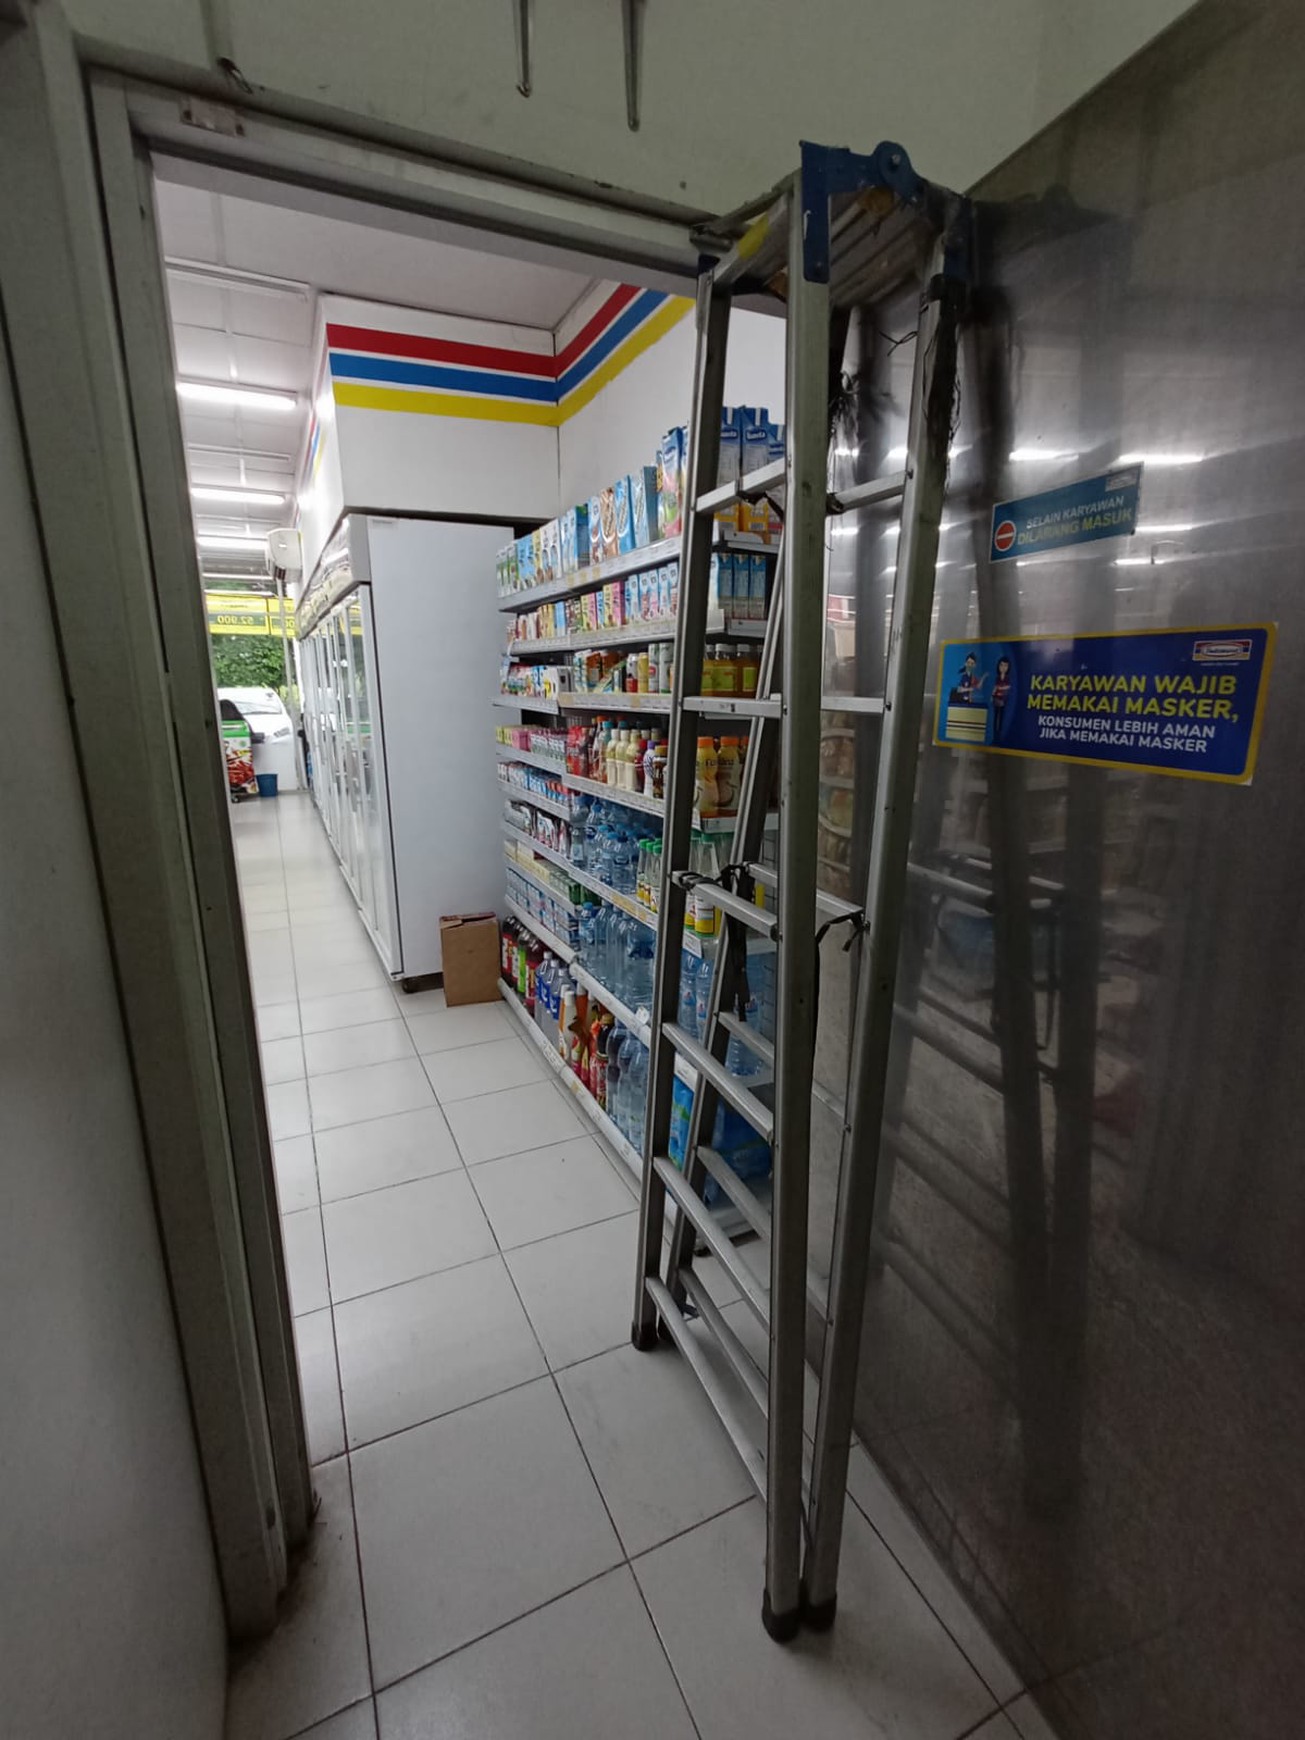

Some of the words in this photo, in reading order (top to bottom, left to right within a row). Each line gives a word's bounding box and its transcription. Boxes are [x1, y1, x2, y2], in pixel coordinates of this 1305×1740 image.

[1026, 511, 1060, 529] SELAIN
[1062, 496, 1125, 520] KARYAWAN
[1082, 508, 1132, 530] MASUK
[1030, 675, 1147, 693] KARYAWAN
[1154, 675, 1237, 695] WAJIB
[1027, 694, 1118, 713] MEMAKAI
[1125, 697, 1239, 723] MASKER,
[1038, 715, 1111, 731] KONSUMEN
[1114, 720, 1159, 735] LEBIH
[1162, 723, 1215, 739] AMAN
[1040, 727, 1066, 740] JIKA
[1070, 730, 1134, 747] MEMAKAI
[1138, 736, 1208, 753] MASKER
